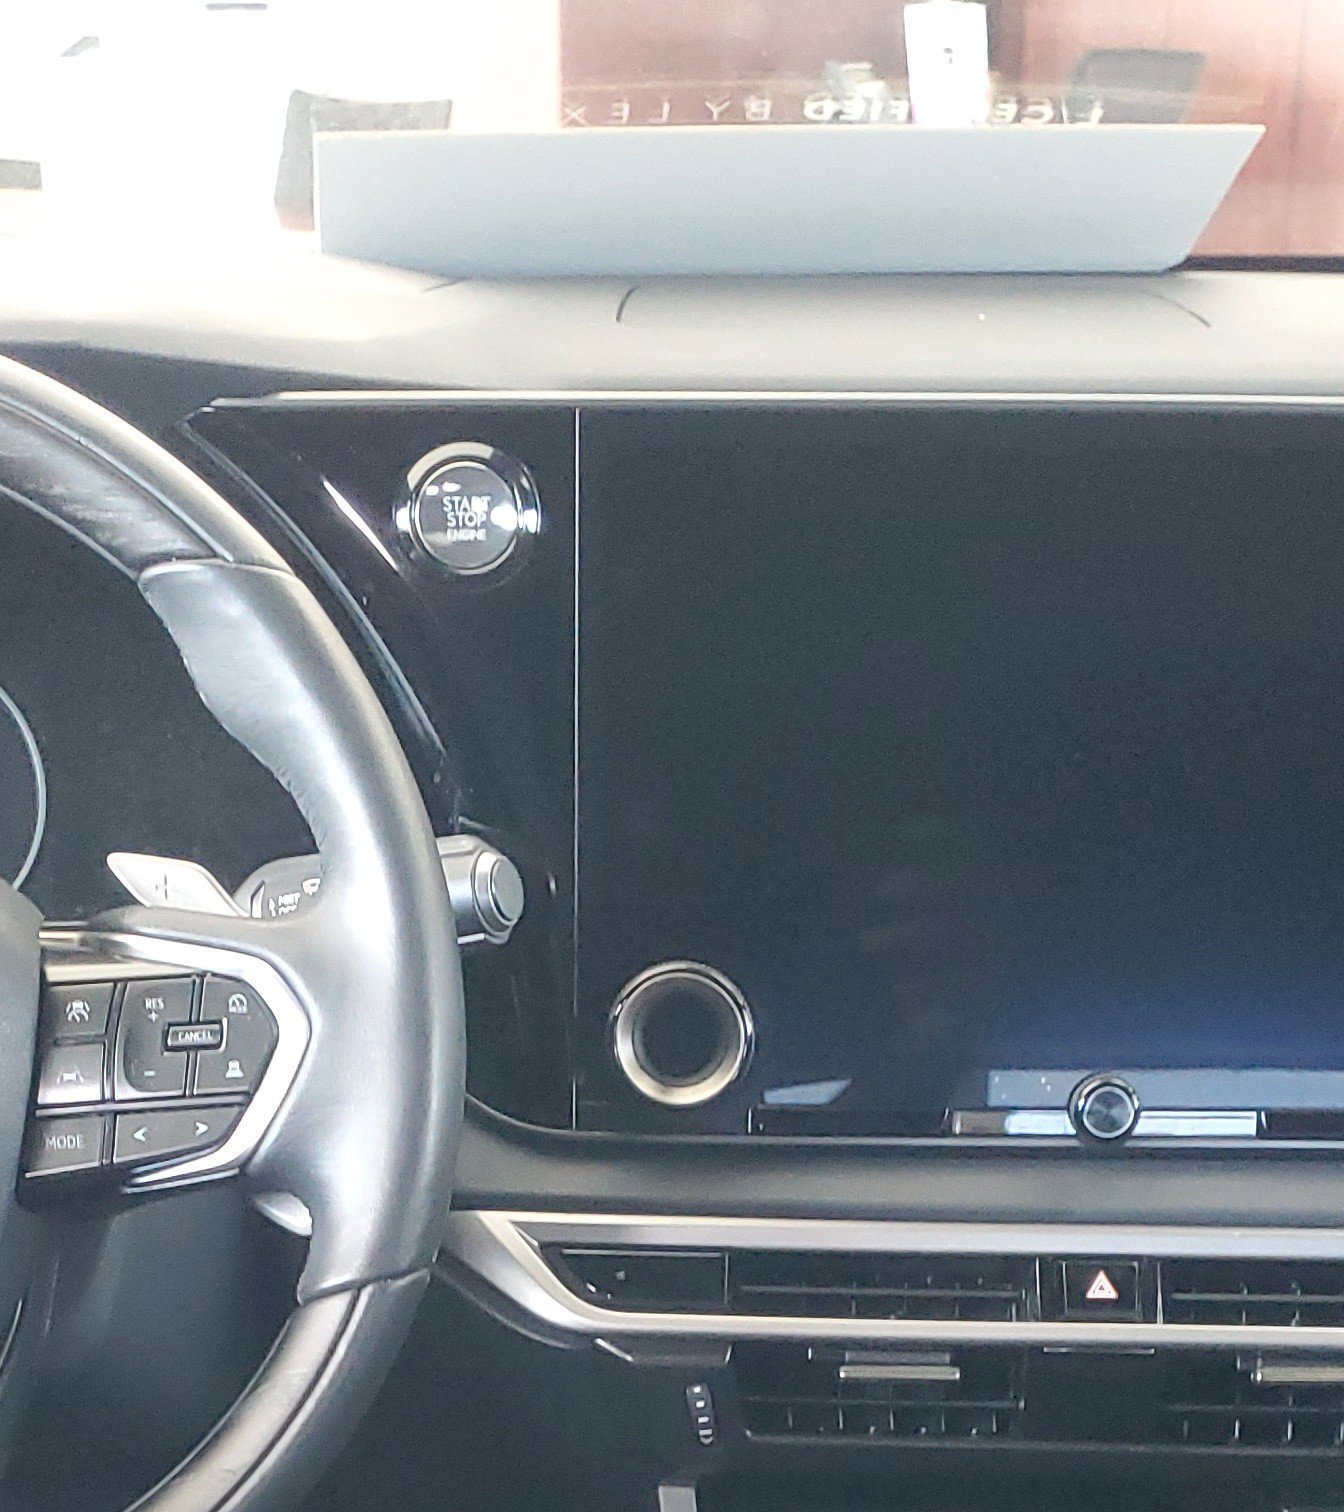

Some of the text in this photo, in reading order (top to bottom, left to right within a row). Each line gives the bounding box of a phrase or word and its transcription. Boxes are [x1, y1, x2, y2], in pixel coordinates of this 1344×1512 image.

[442, 496, 491, 512] START
[446, 511, 487, 528] STOP
[144, 997, 165, 1011] RES
[177, 1030, 213, 1044] CANCEL
[44, 1132, 85, 1150] MODE
